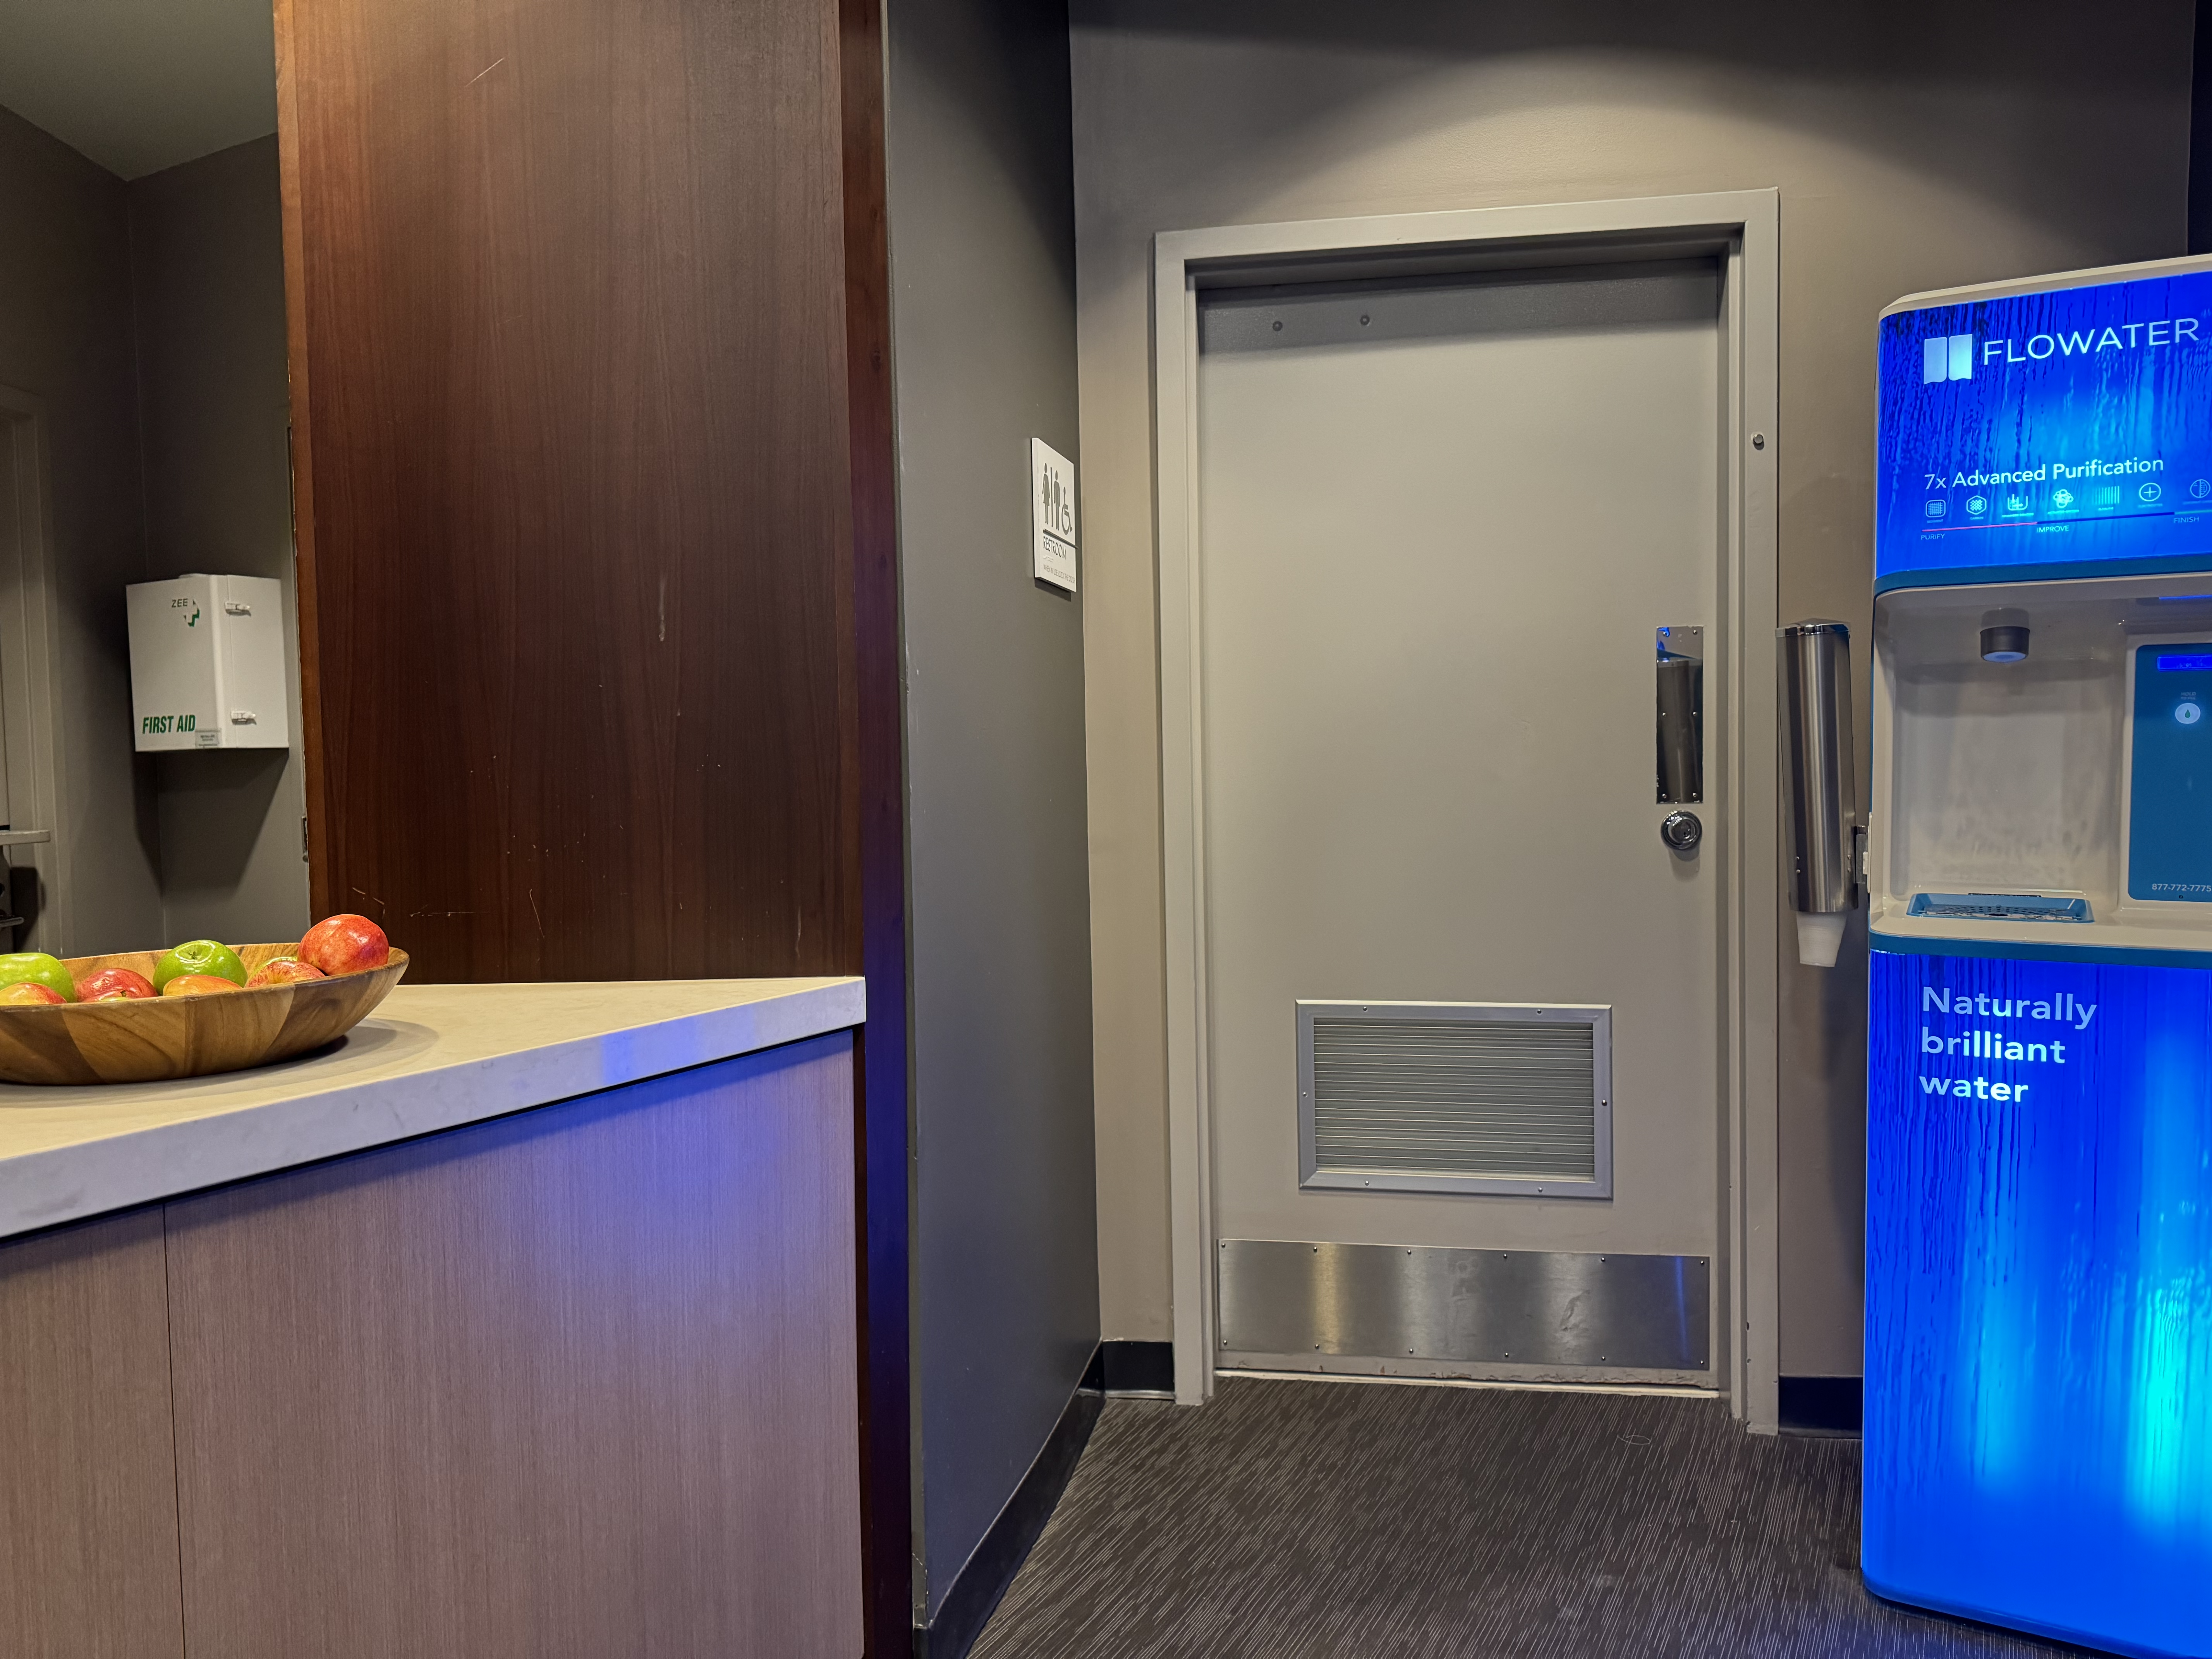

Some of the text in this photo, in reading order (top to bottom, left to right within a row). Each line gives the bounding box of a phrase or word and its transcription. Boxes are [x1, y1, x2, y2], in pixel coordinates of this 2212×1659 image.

[1984, 318, 2199, 366] FLOWATER
[1924, 457, 2164, 491] 7x Advanced Purification
[2037, 524, 2069, 534] IMPROVE
[1043, 536, 1066, 560] RESTROOM
[172, 598, 188, 608] ZEE
[142, 714, 196, 734] FIRST AID
[2152, 883, 2212, 892] 877-772-7775
[1922, 986, 2097, 1030] Naturally
[1922, 1027, 2066, 1064] brilliant
[1919, 1076, 2028, 1103] water
